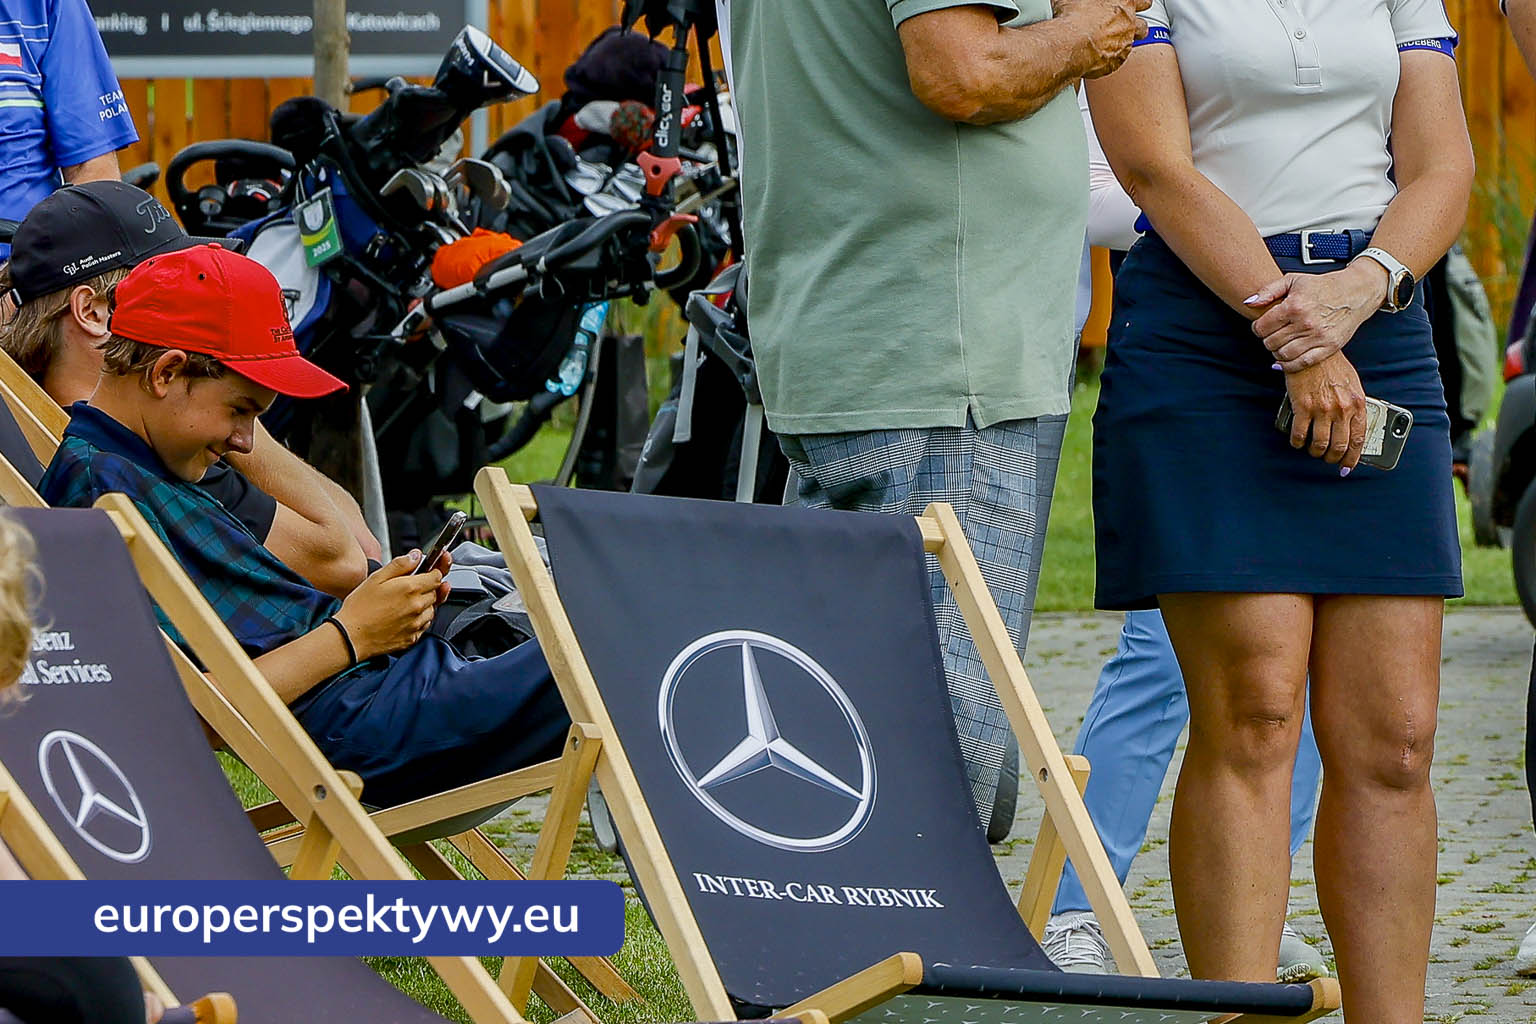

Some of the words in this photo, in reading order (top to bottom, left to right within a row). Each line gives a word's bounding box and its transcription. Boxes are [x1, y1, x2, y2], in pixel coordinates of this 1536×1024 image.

[79, 256, 93, 265] Audi
[81, 259, 99, 270] Polish
[98, 251, 121, 263] Masters
[36, 658, 112, 684] Services
[693, 872, 842, 906] INTER-CAR
[841, 886, 945, 909] RYBNIK
